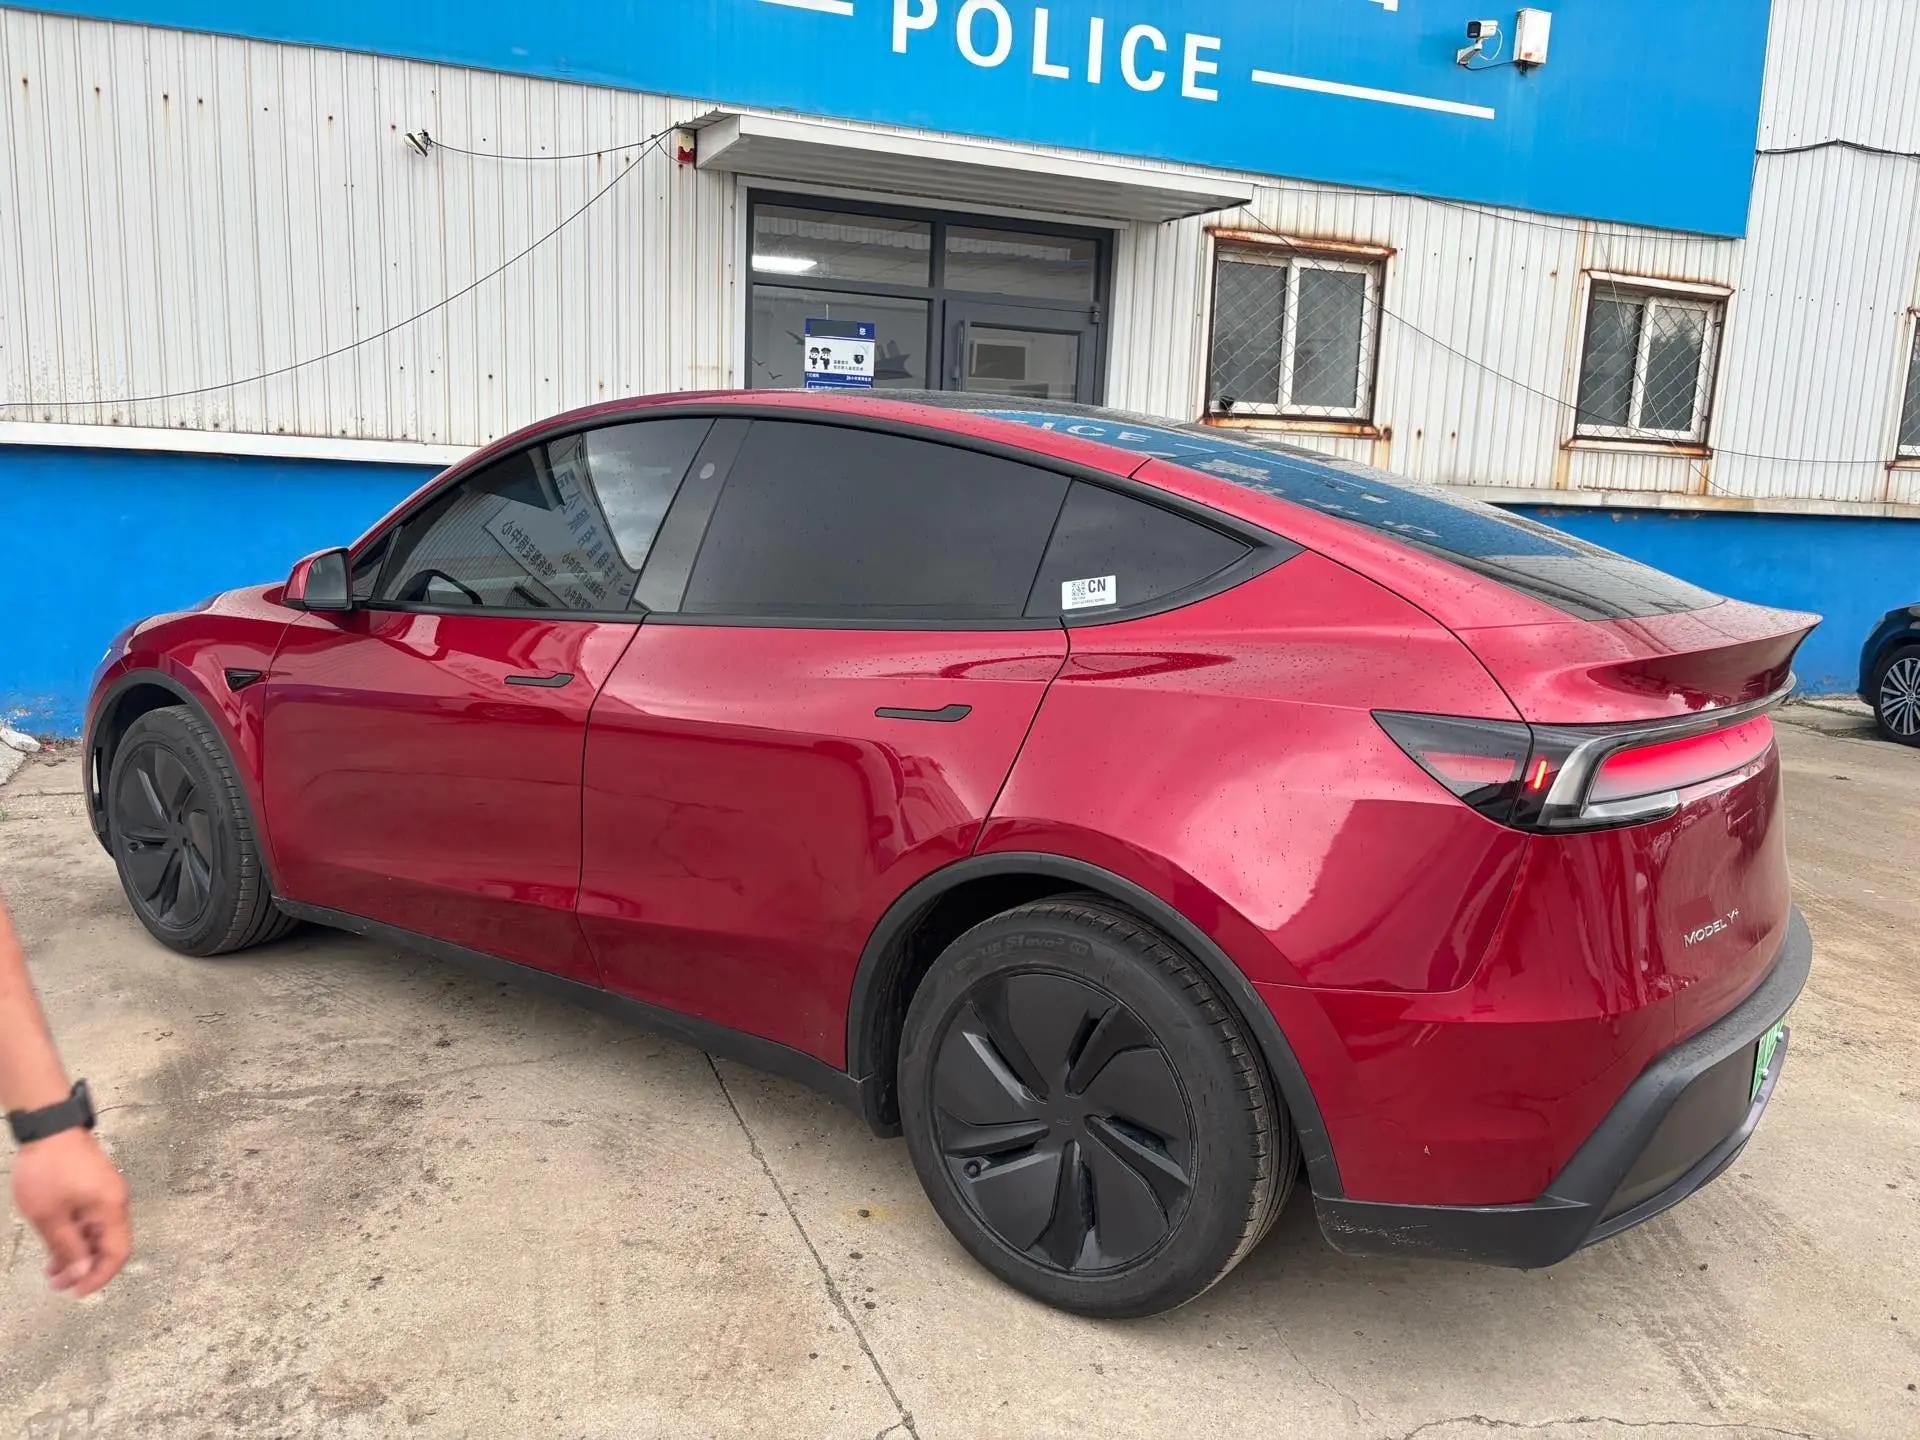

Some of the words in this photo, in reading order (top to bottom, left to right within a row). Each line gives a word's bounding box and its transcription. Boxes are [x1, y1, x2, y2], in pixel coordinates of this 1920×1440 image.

[892, 0, 1222, 101] POLICE
[1088, 578, 1106, 593] CN
[1684, 919, 1727, 948] MODEL
